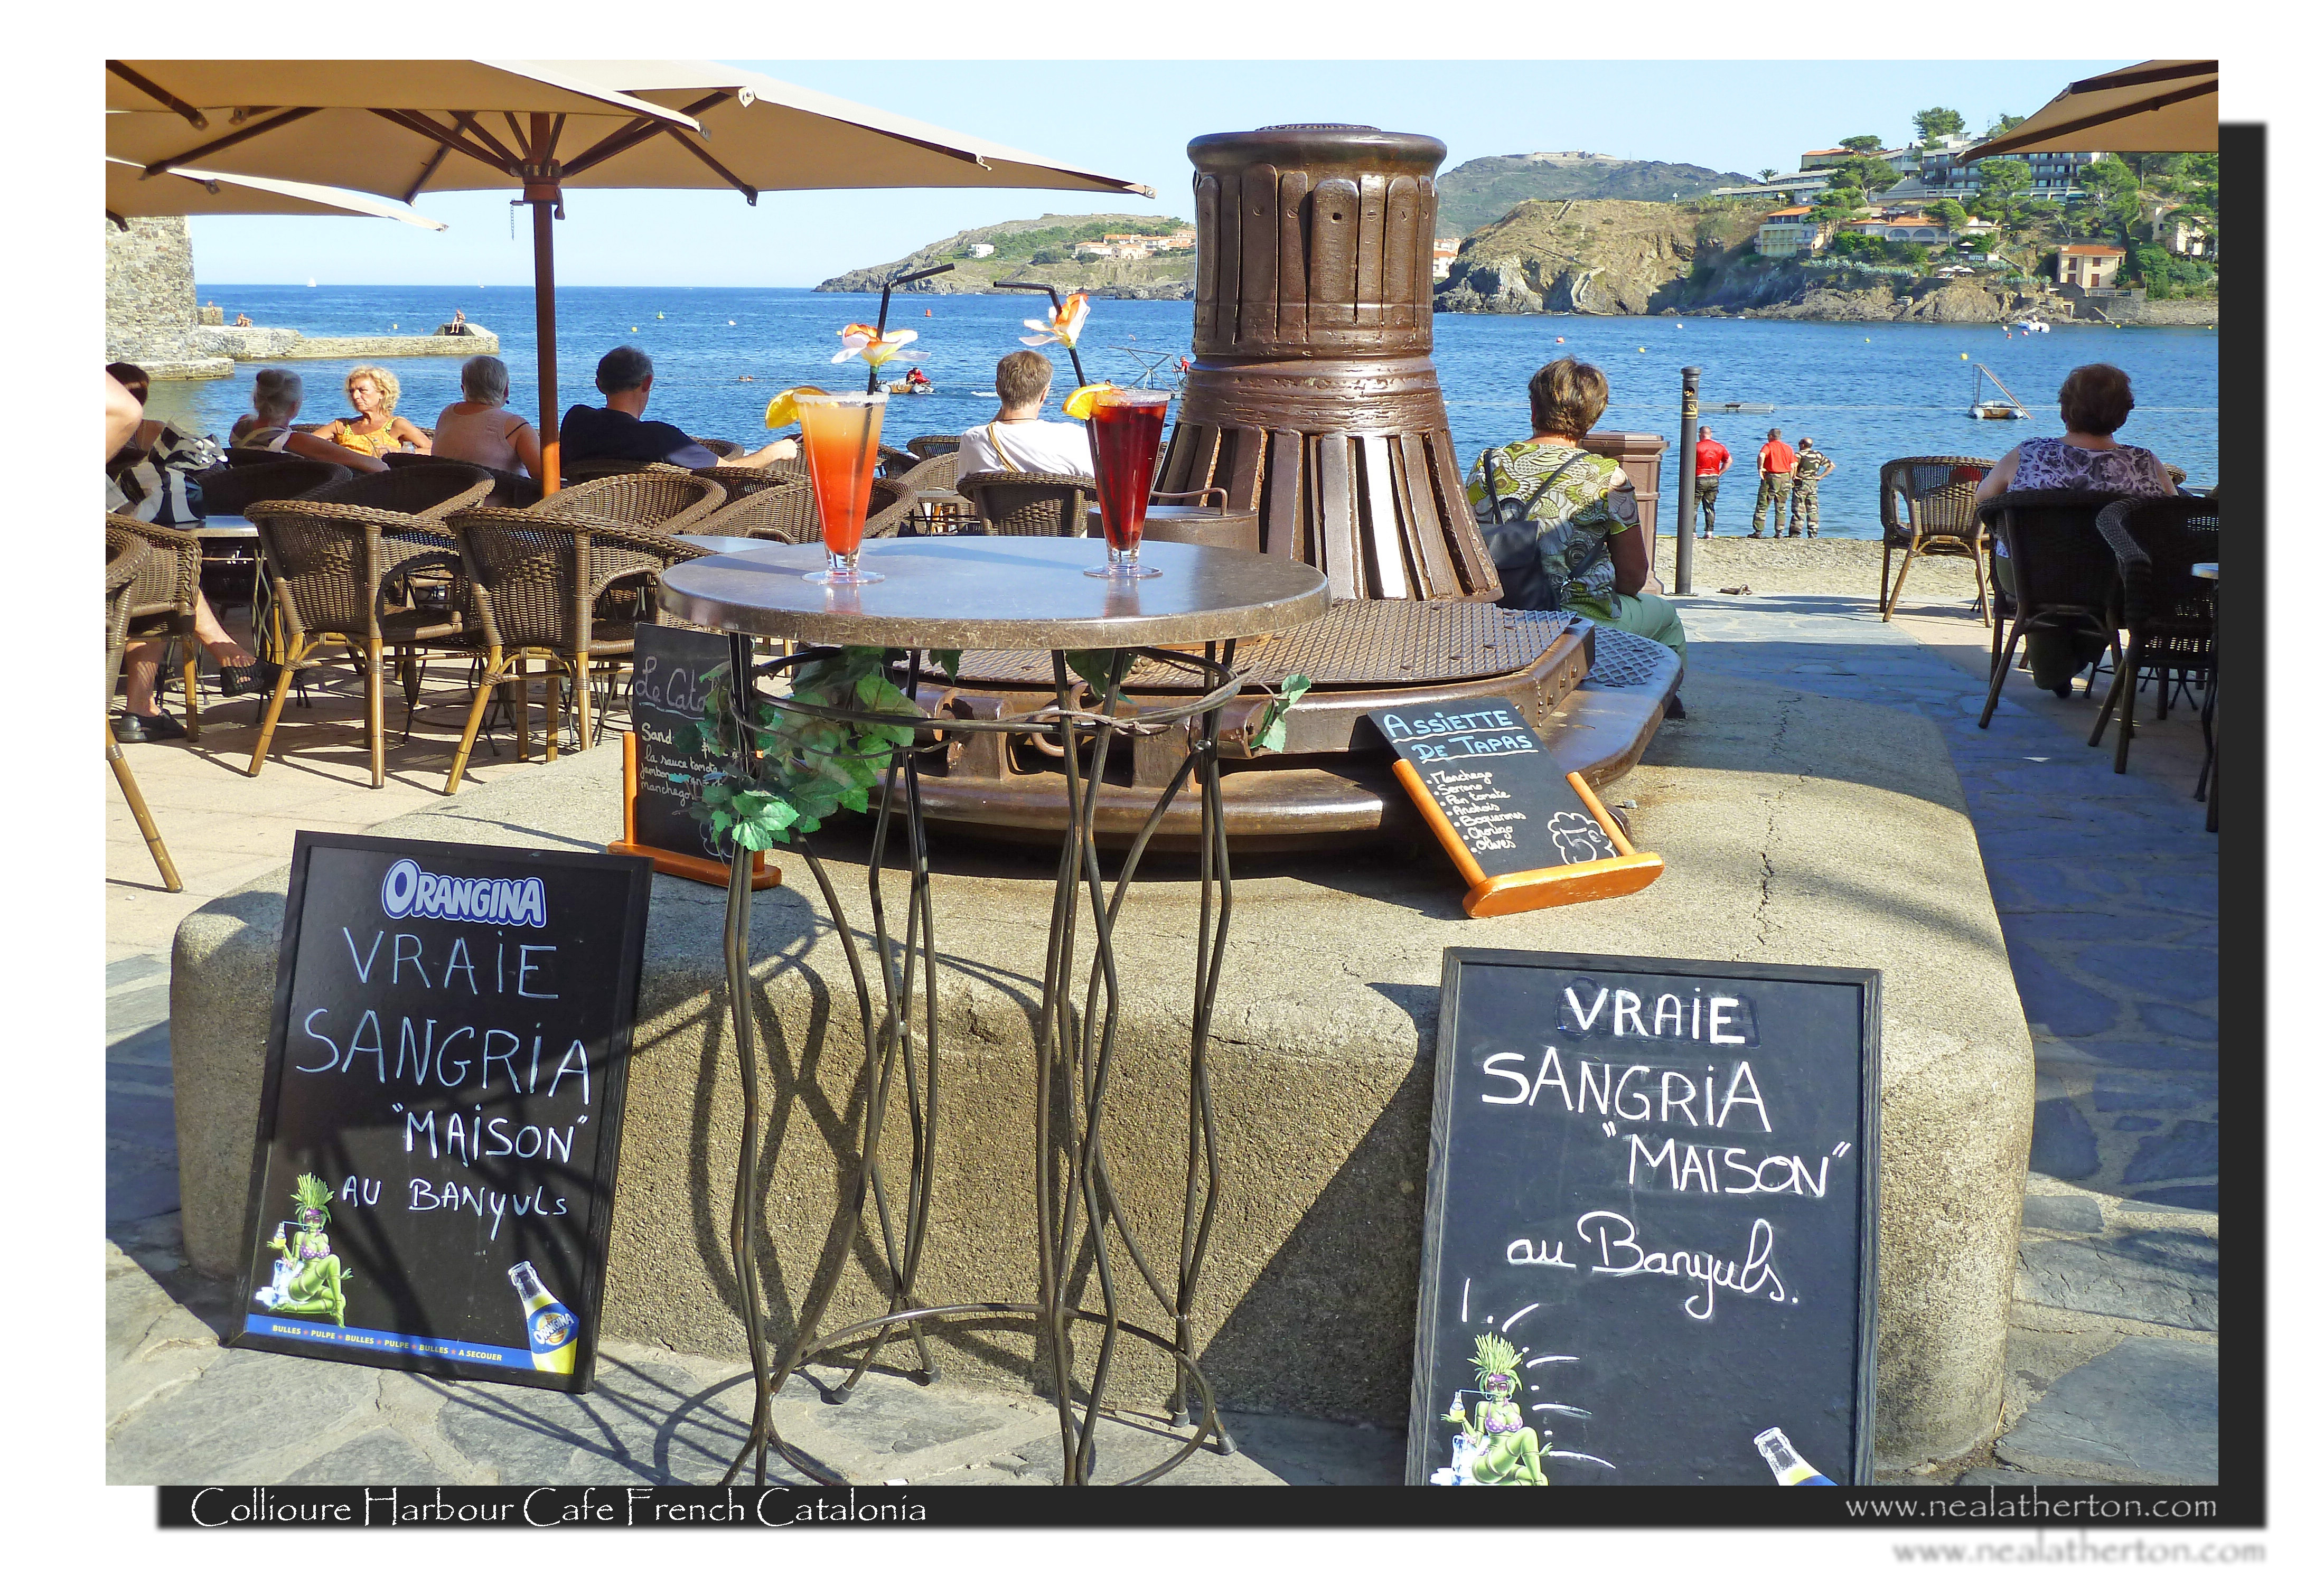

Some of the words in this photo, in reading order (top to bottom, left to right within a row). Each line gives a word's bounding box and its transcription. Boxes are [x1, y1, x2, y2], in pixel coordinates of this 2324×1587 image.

[635, 655, 660, 702] Le
[667, 668, 706, 712] Cata
[641, 722, 672, 745] Sand
[645, 744, 658, 763] la
[660, 755, 688, 768] sauce
[1411, 744, 1448, 760] DE
[1448, 735, 1532, 754] TAPAS
[1430, 769, 1493, 785] Manchego
[1437, 784, 1483, 795] Serrano
[1446, 795, 1469, 805] Pan
[1468, 787, 1511, 801] tomate
[1452, 802, 1500, 815] Anchois
[1459, 812, 1526, 828] Boquerones
[1468, 826, 1513, 839] Chorizo
[1476, 835, 1516, 850] Olives
[385, 860, 544, 924] ORANGINA
[343, 1176, 381, 1207] AU
[1506, 1238, 1577, 1268] au
[1577, 1210, 1798, 1319] Banyuls.
[533, 1313, 575, 1345] ORANGINA
[273, 1325, 301, 1335] BULLES
[311, 1330, 335, 1339] PULPE
[345, 1334, 374, 1345] BULLES
[384, 1339, 409, 1349] PULPE
[419, 1344, 448, 1355] BULLES
[466, 1350, 502, 1361] SECOUER
